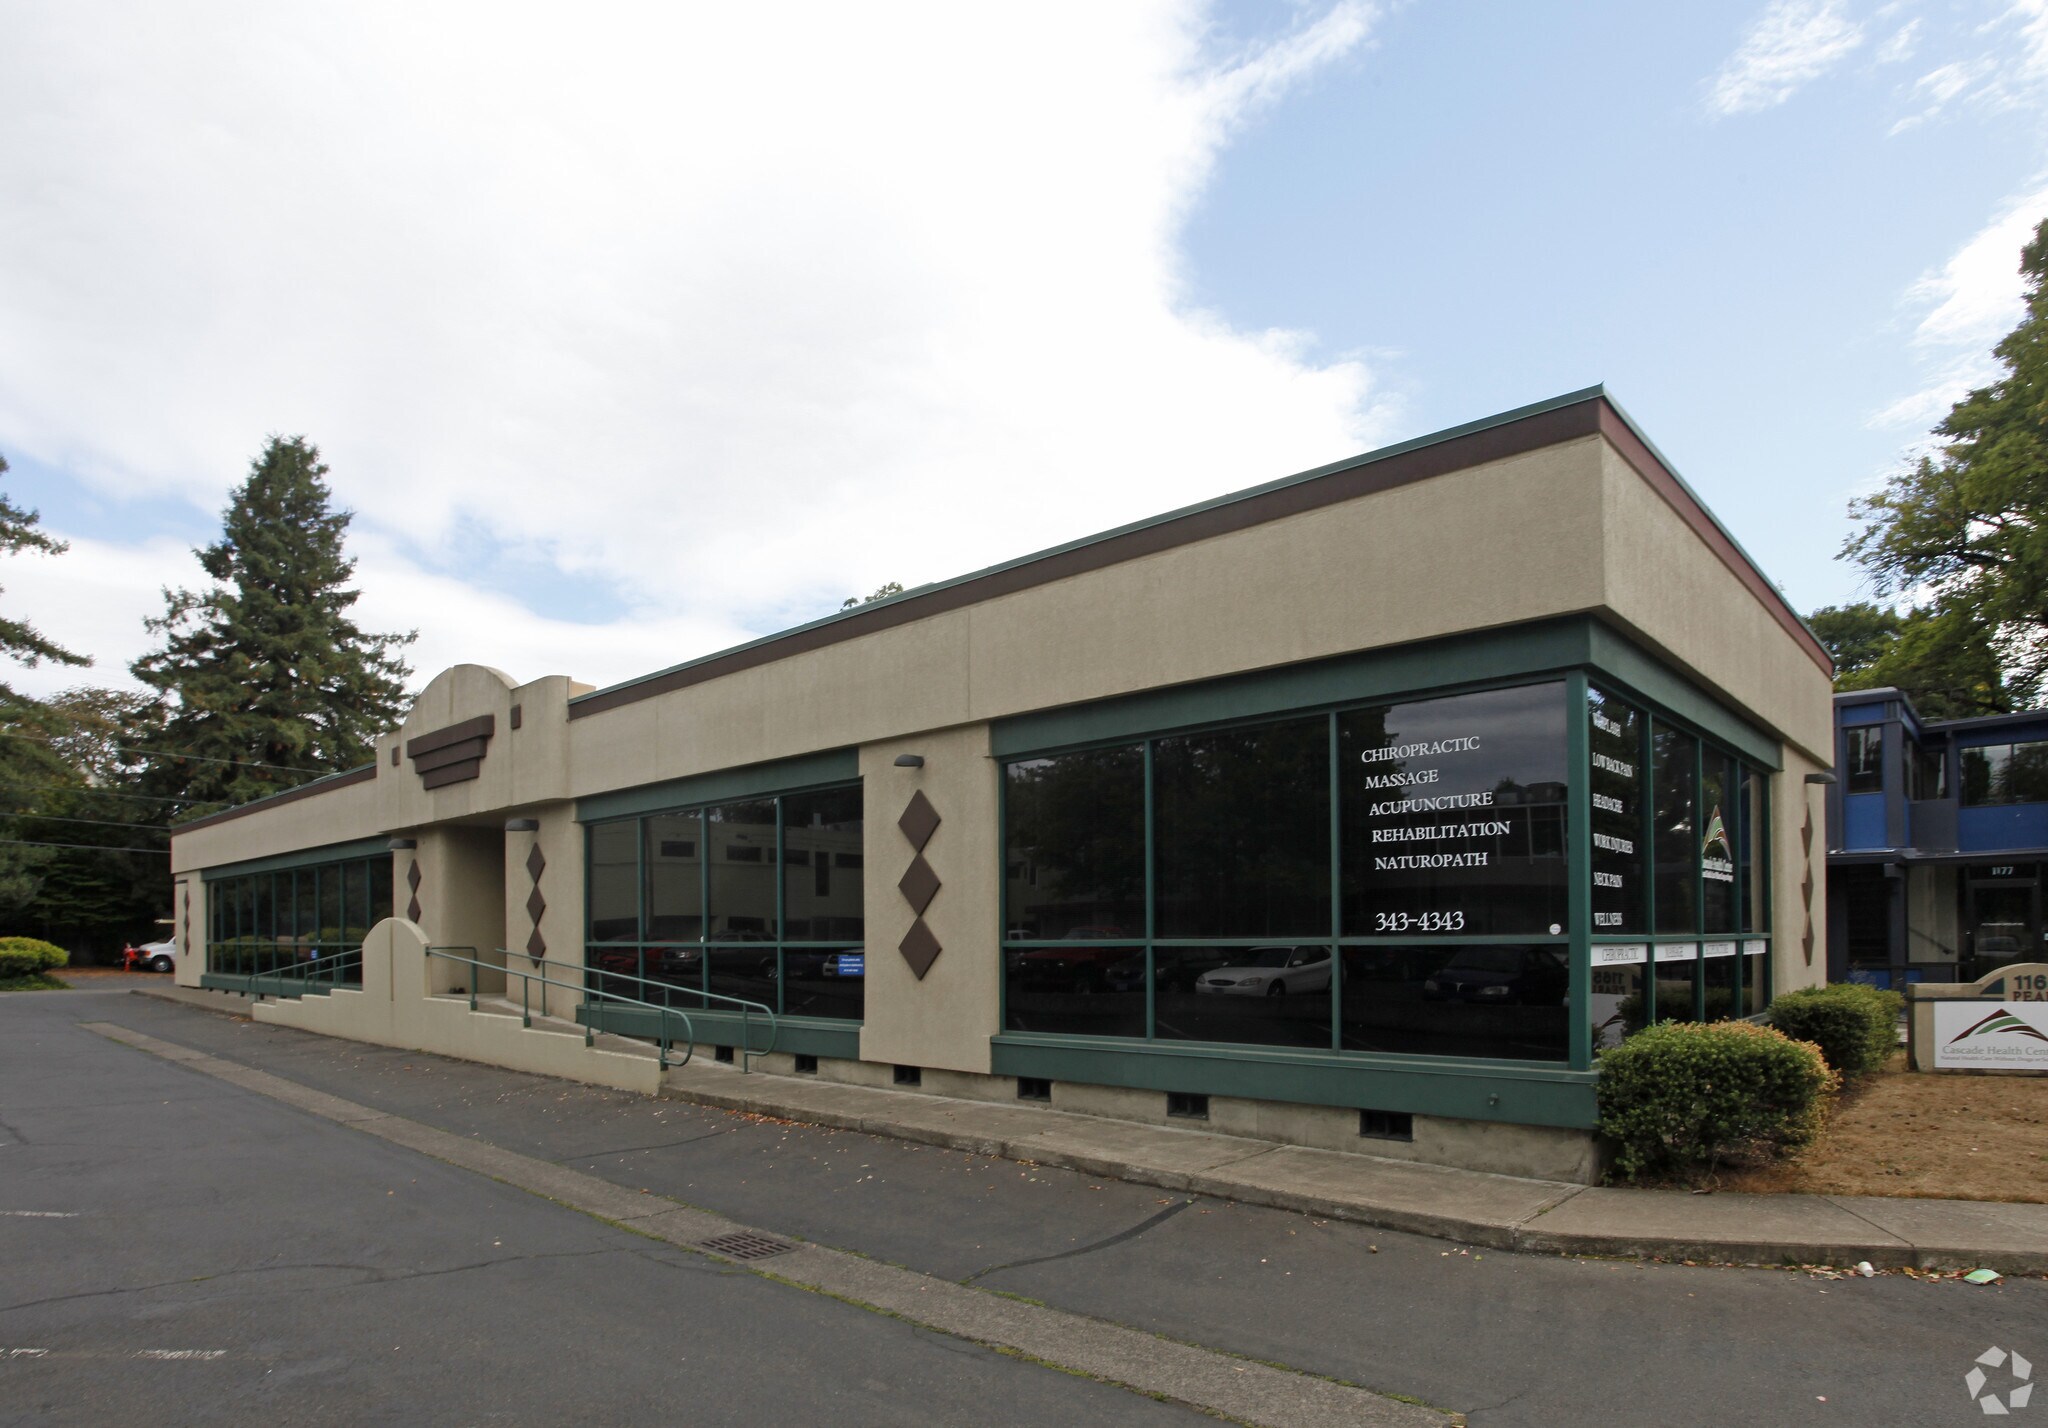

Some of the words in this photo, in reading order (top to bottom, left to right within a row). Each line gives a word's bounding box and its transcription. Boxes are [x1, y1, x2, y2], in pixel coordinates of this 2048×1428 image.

[1361, 736, 1480, 763] CHIROPRACTIC
[1365, 769, 1439, 789] MASSAGE
[1369, 792, 1493, 816] ACUPUNCTURE
[1372, 821, 1511, 843] REHABILITATION
[1375, 852, 1488, 870] NATUROPATH
[1992, 866, 2014, 876] 1177
[1375, 911, 1465, 931] 343-4343
[2013, 991, 2048, 1002] PEA
[1942, 1045, 1984, 1055] Cascade
[1987, 1046, 2022, 1055] Health
[2025, 1046, 2048, 1056] Cen
